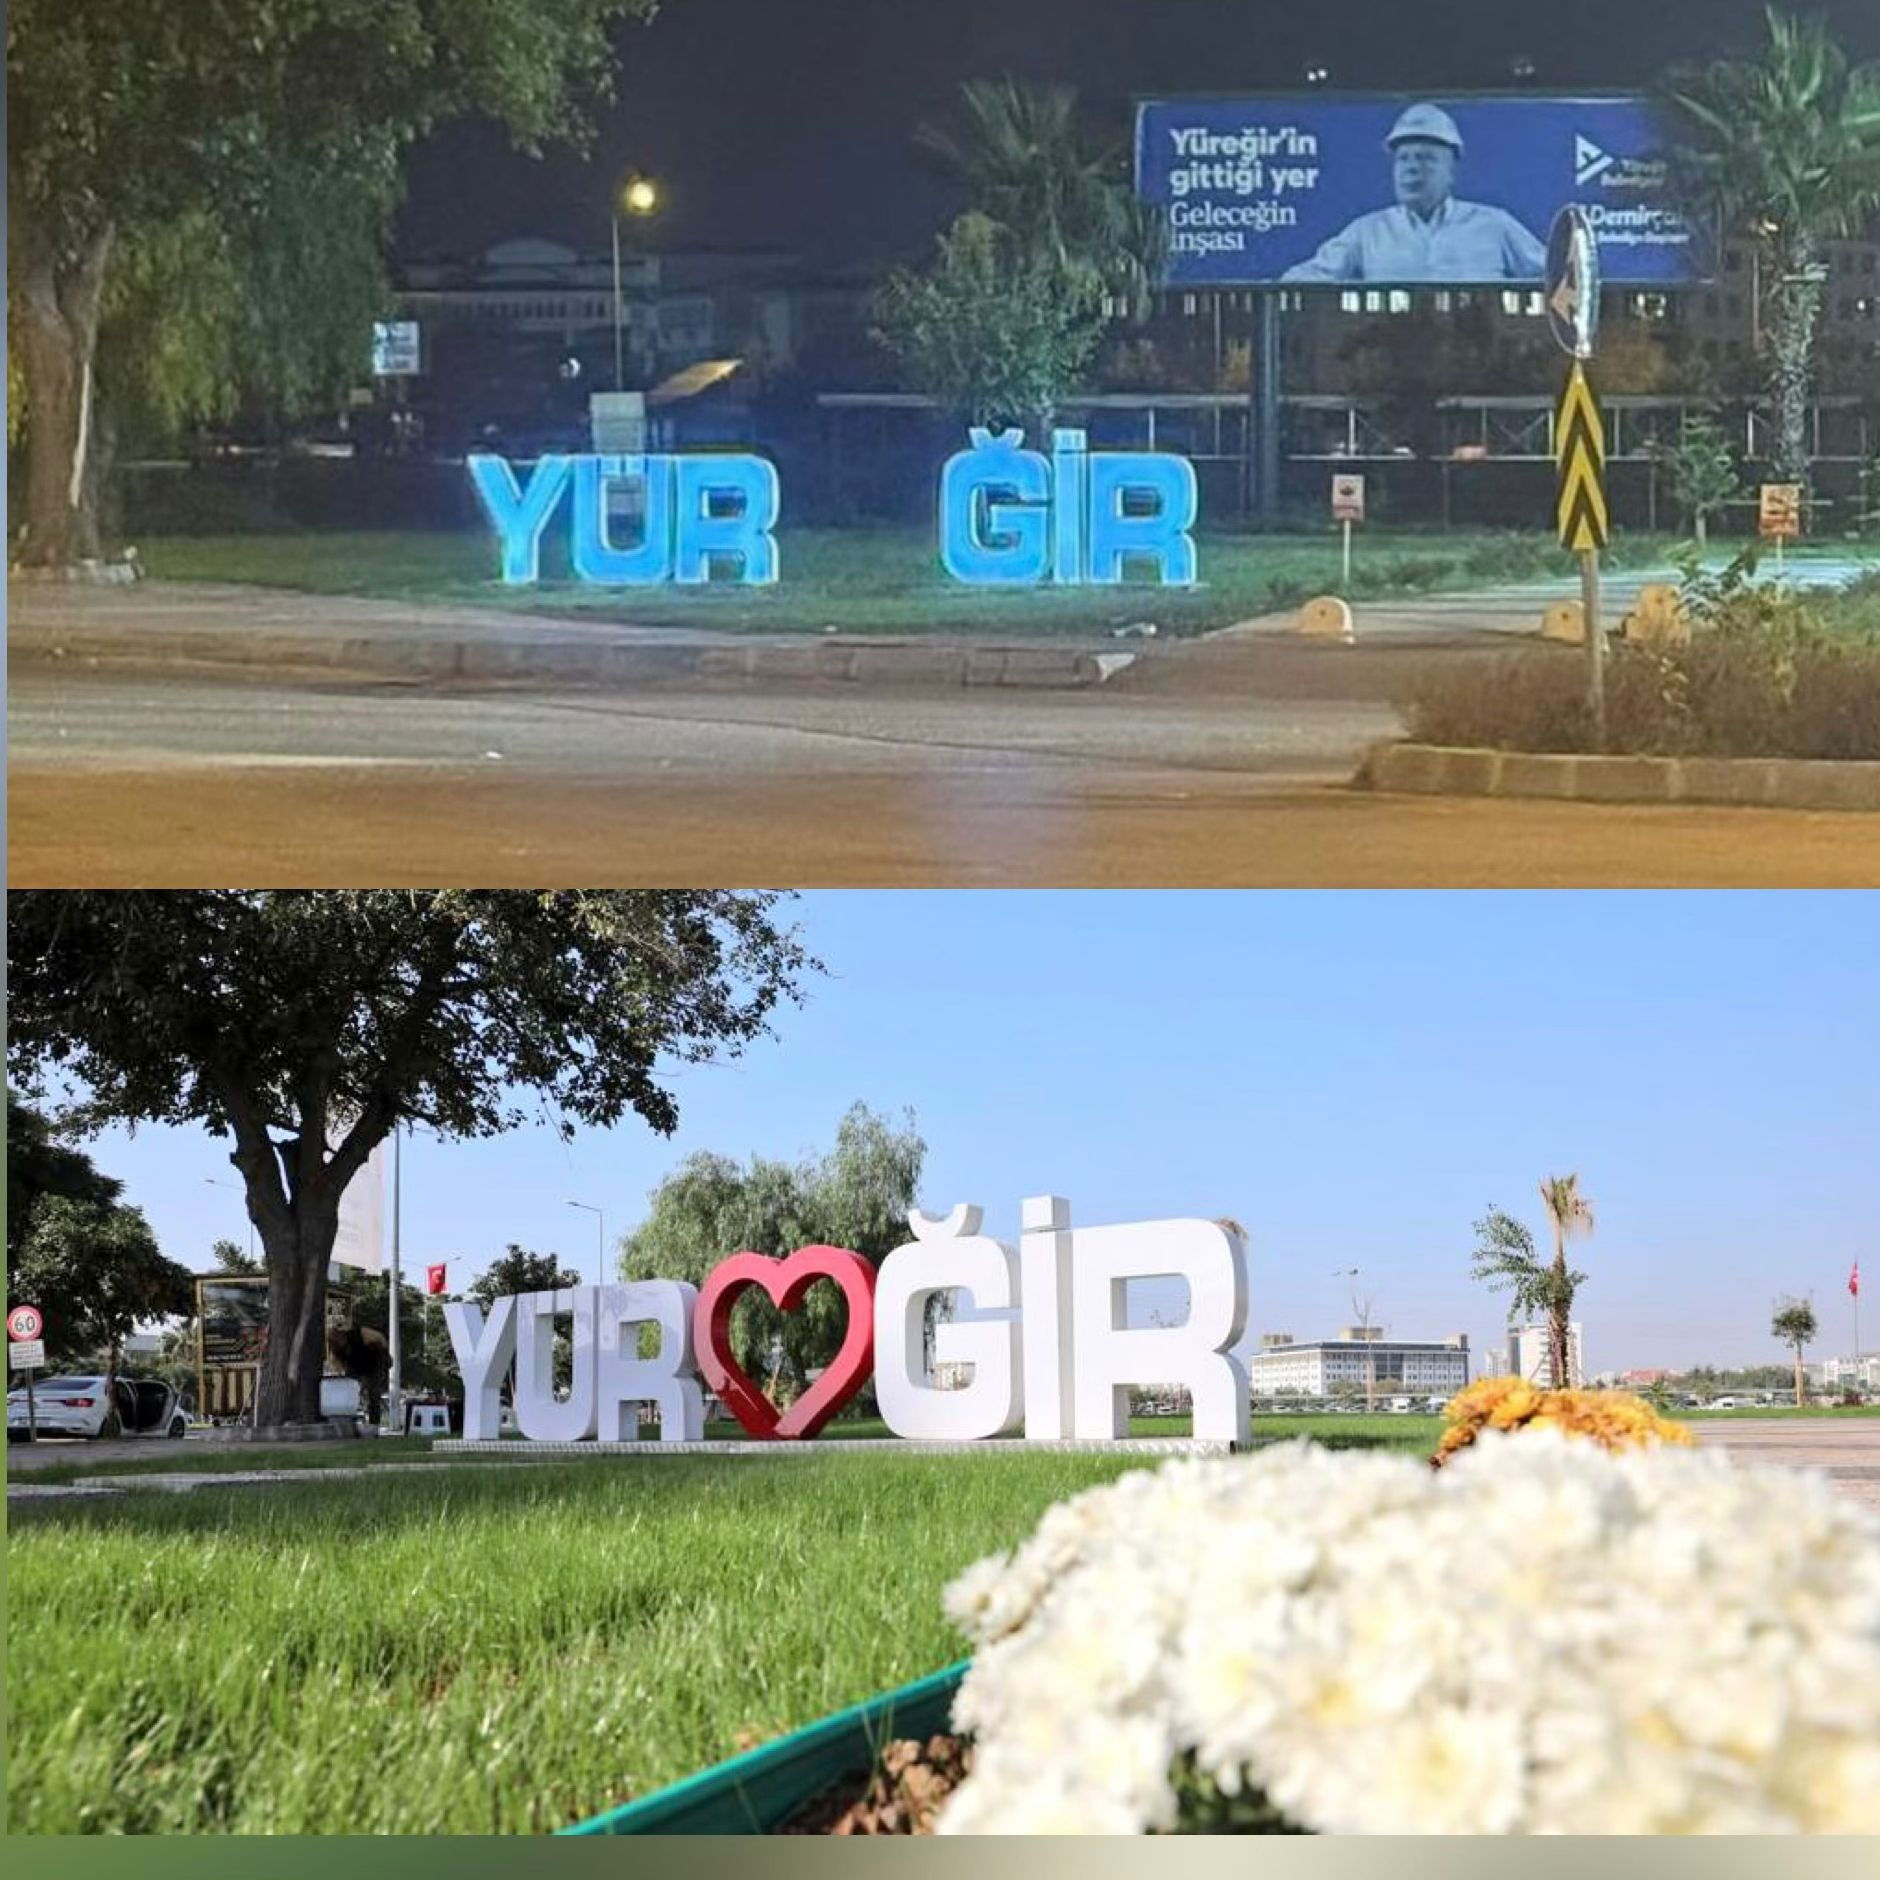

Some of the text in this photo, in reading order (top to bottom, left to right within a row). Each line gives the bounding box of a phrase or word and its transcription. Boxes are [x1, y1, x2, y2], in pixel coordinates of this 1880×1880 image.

[1168, 126, 1318, 166] Yüreğir'in
[1169, 160, 1320, 196] gittiği yer
[1169, 200, 1297, 232] Geleceğin
[467, 427, 1198, 585] YÜR ĞİR
[14, 1314, 36, 1332] 60
[442, 1195, 1252, 1442] YÜR ĞİR
